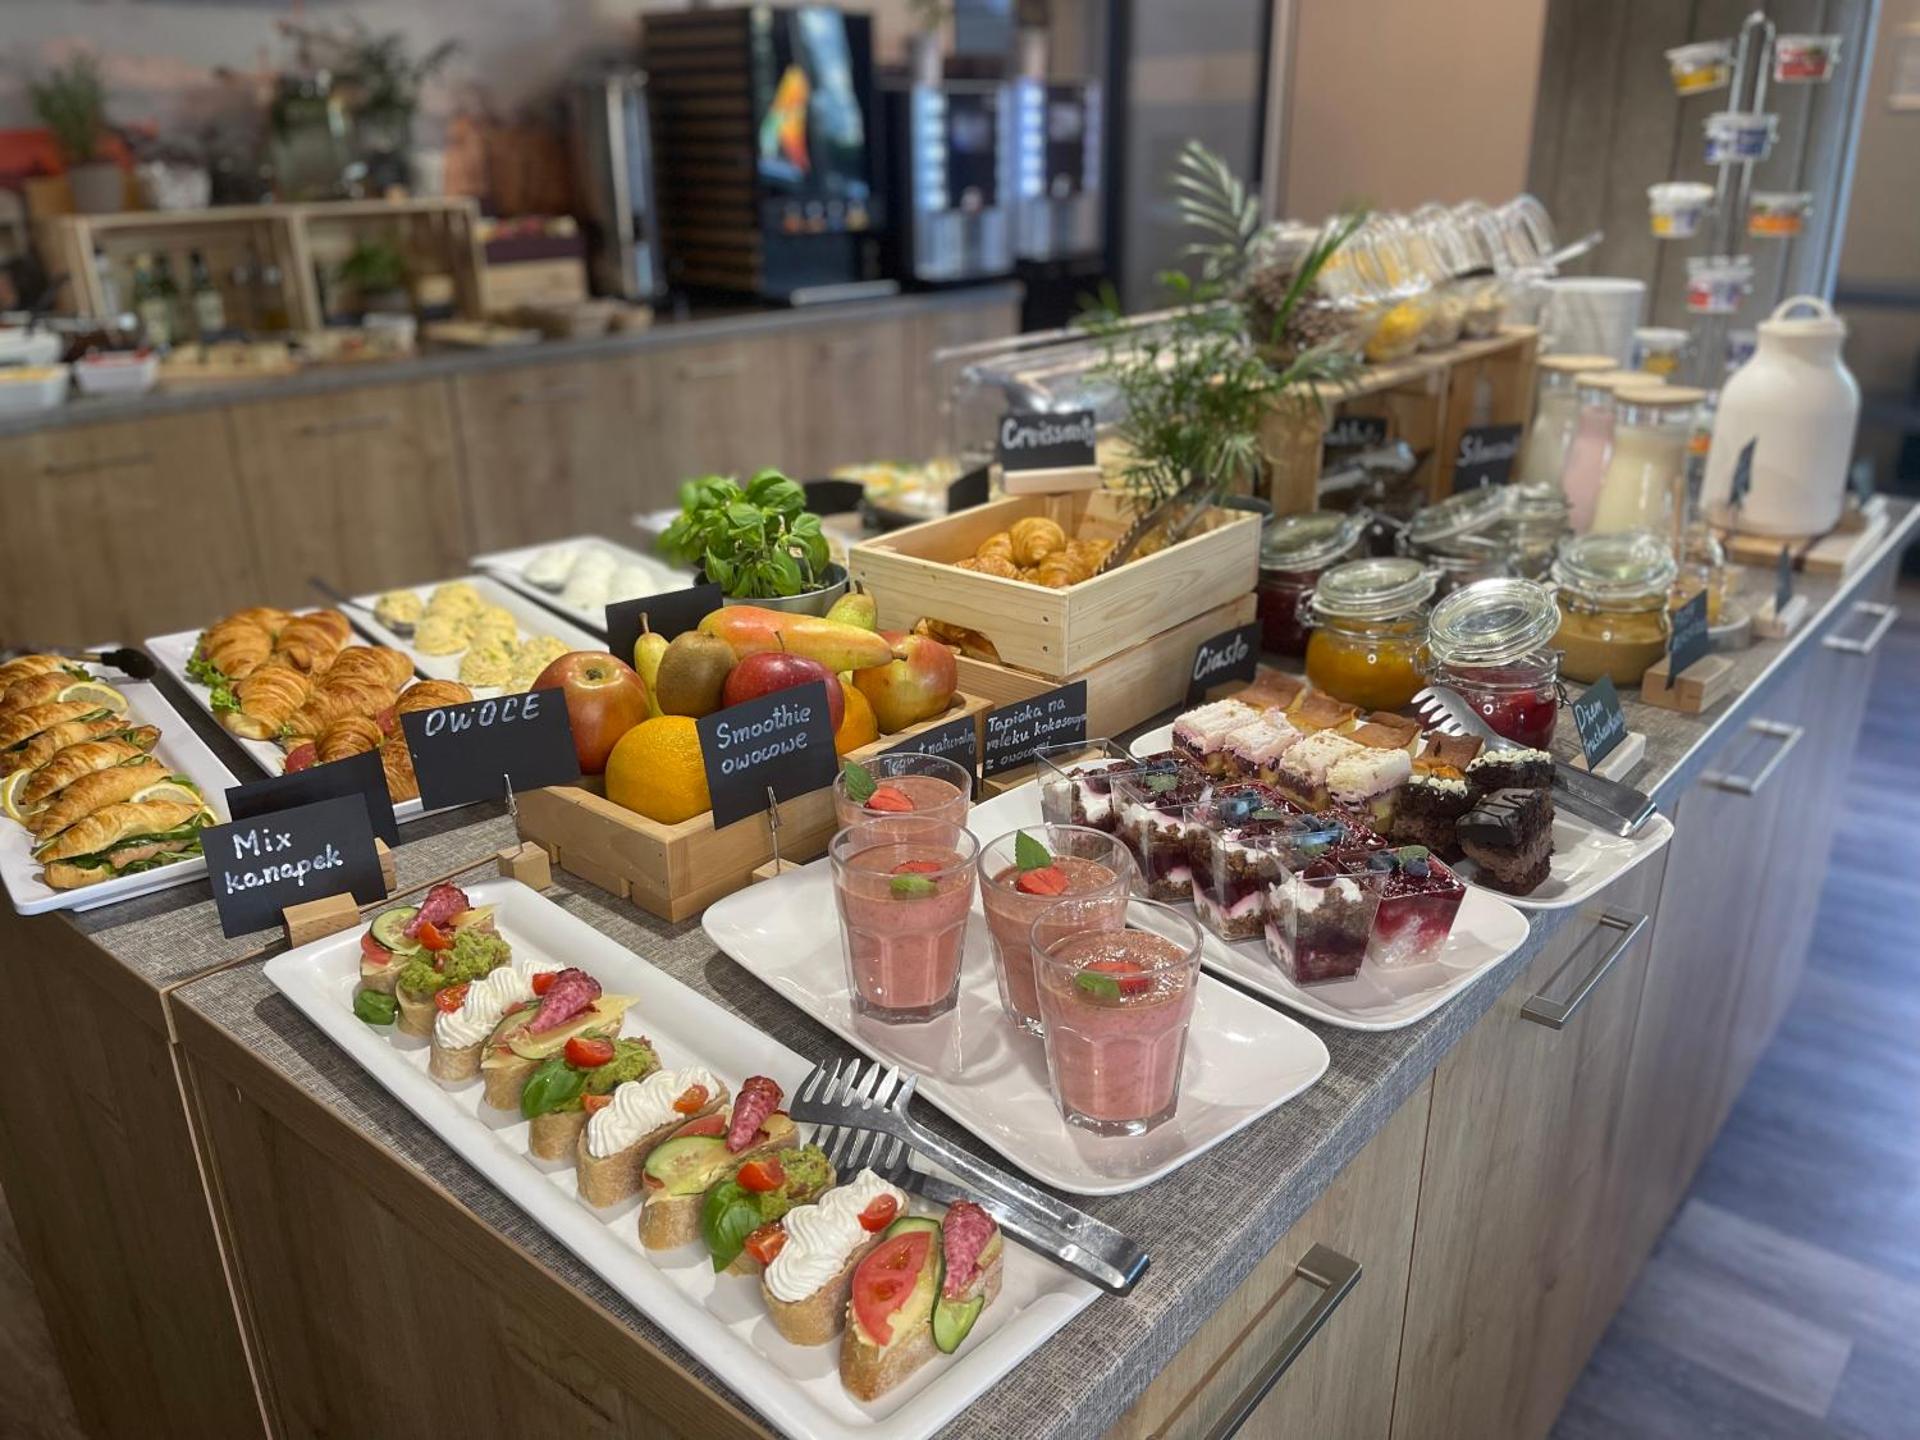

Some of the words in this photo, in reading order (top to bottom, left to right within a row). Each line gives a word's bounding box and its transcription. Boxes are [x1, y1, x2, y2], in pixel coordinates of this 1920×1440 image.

[1193, 633, 1249, 680] Ciasto
[425, 693, 541, 737] OWOCE
[716, 703, 811, 749] Smoothie
[987, 704, 1043, 736] Tapioka
[1048, 698, 1066, 713] na
[721, 732, 808, 774] owocowe
[986, 729, 1030, 751] mleku
[985, 759, 994, 770] z
[232, 828, 292, 860] Mix
[224, 843, 344, 895] kanapek
